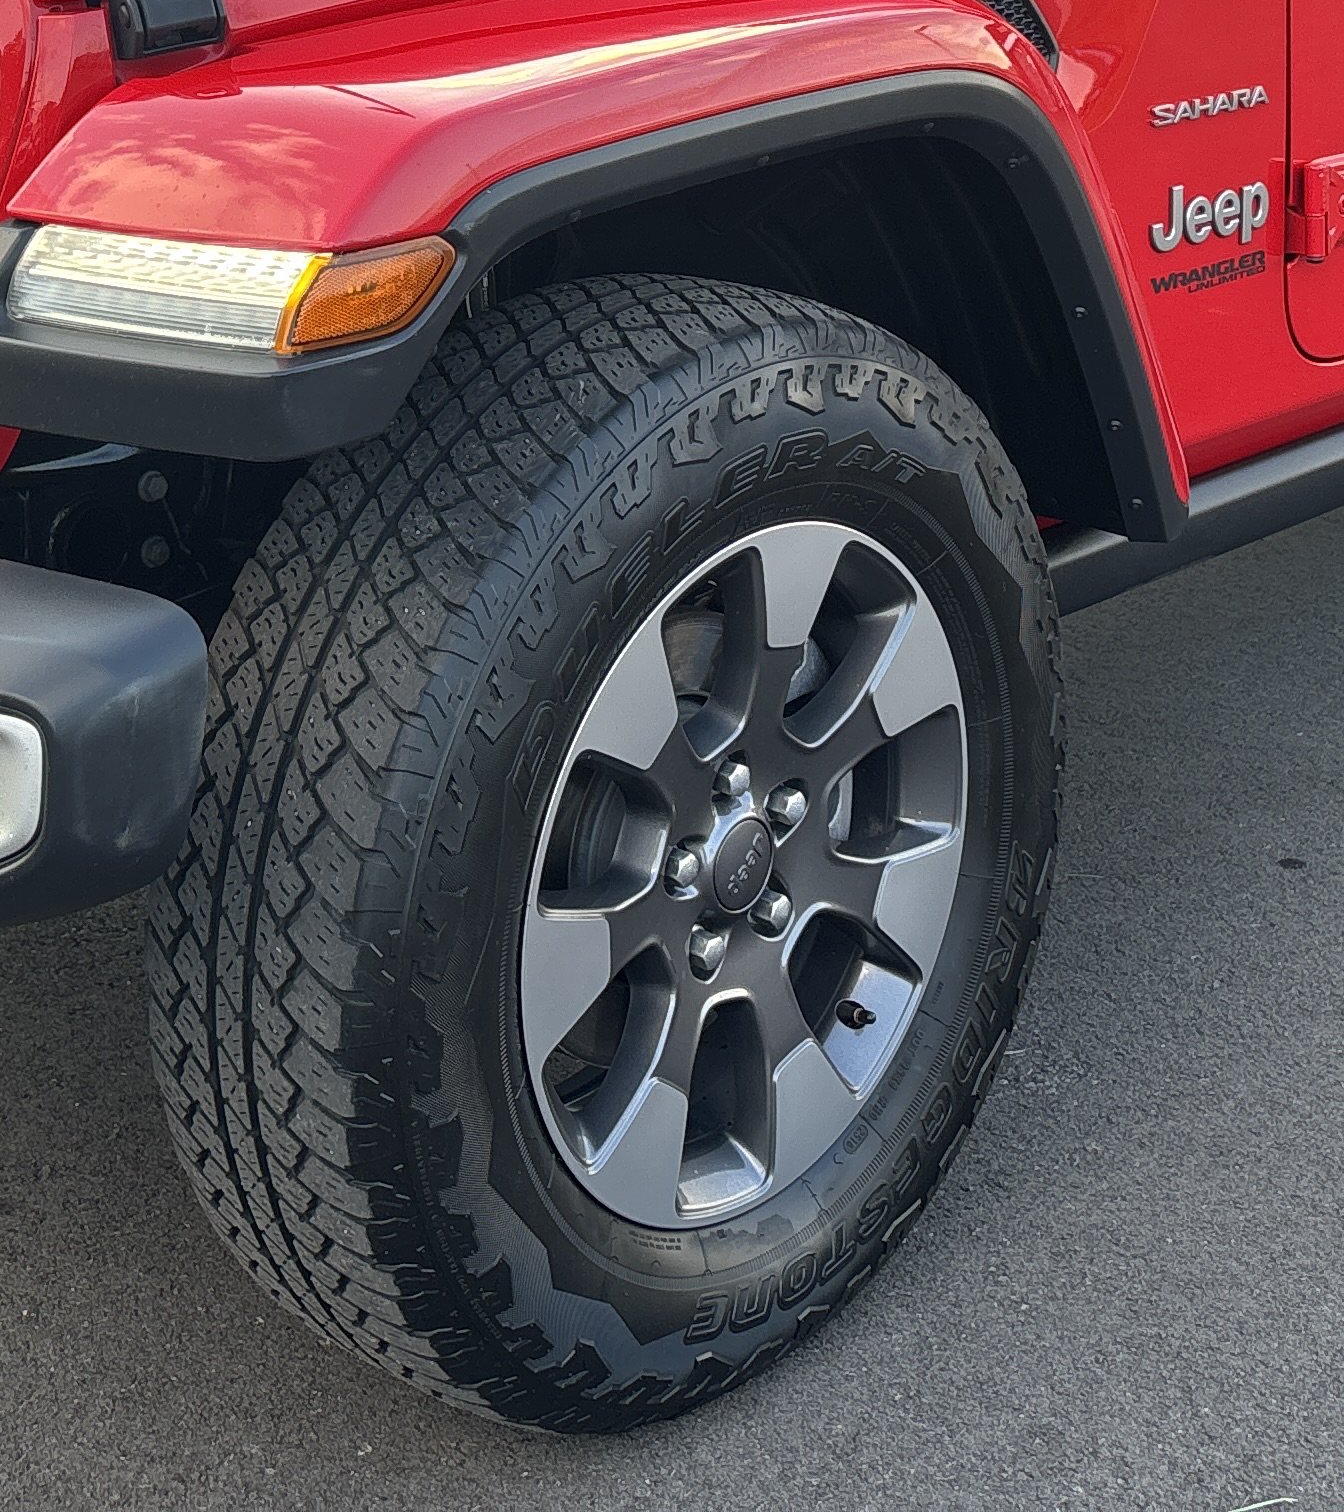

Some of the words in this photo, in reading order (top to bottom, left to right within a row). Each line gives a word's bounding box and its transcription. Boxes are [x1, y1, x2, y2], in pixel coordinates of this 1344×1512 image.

[1147, 84, 1269, 128] SAHARA
[1149, 181, 1270, 253] Jeep
[1150, 250, 1266, 294] WRANGLER
[1187, 265, 1266, 294] UNLIMITED
[836, 443, 933, 485] A/T
[682, 840, 1034, 1346] BRIDGESTONE
